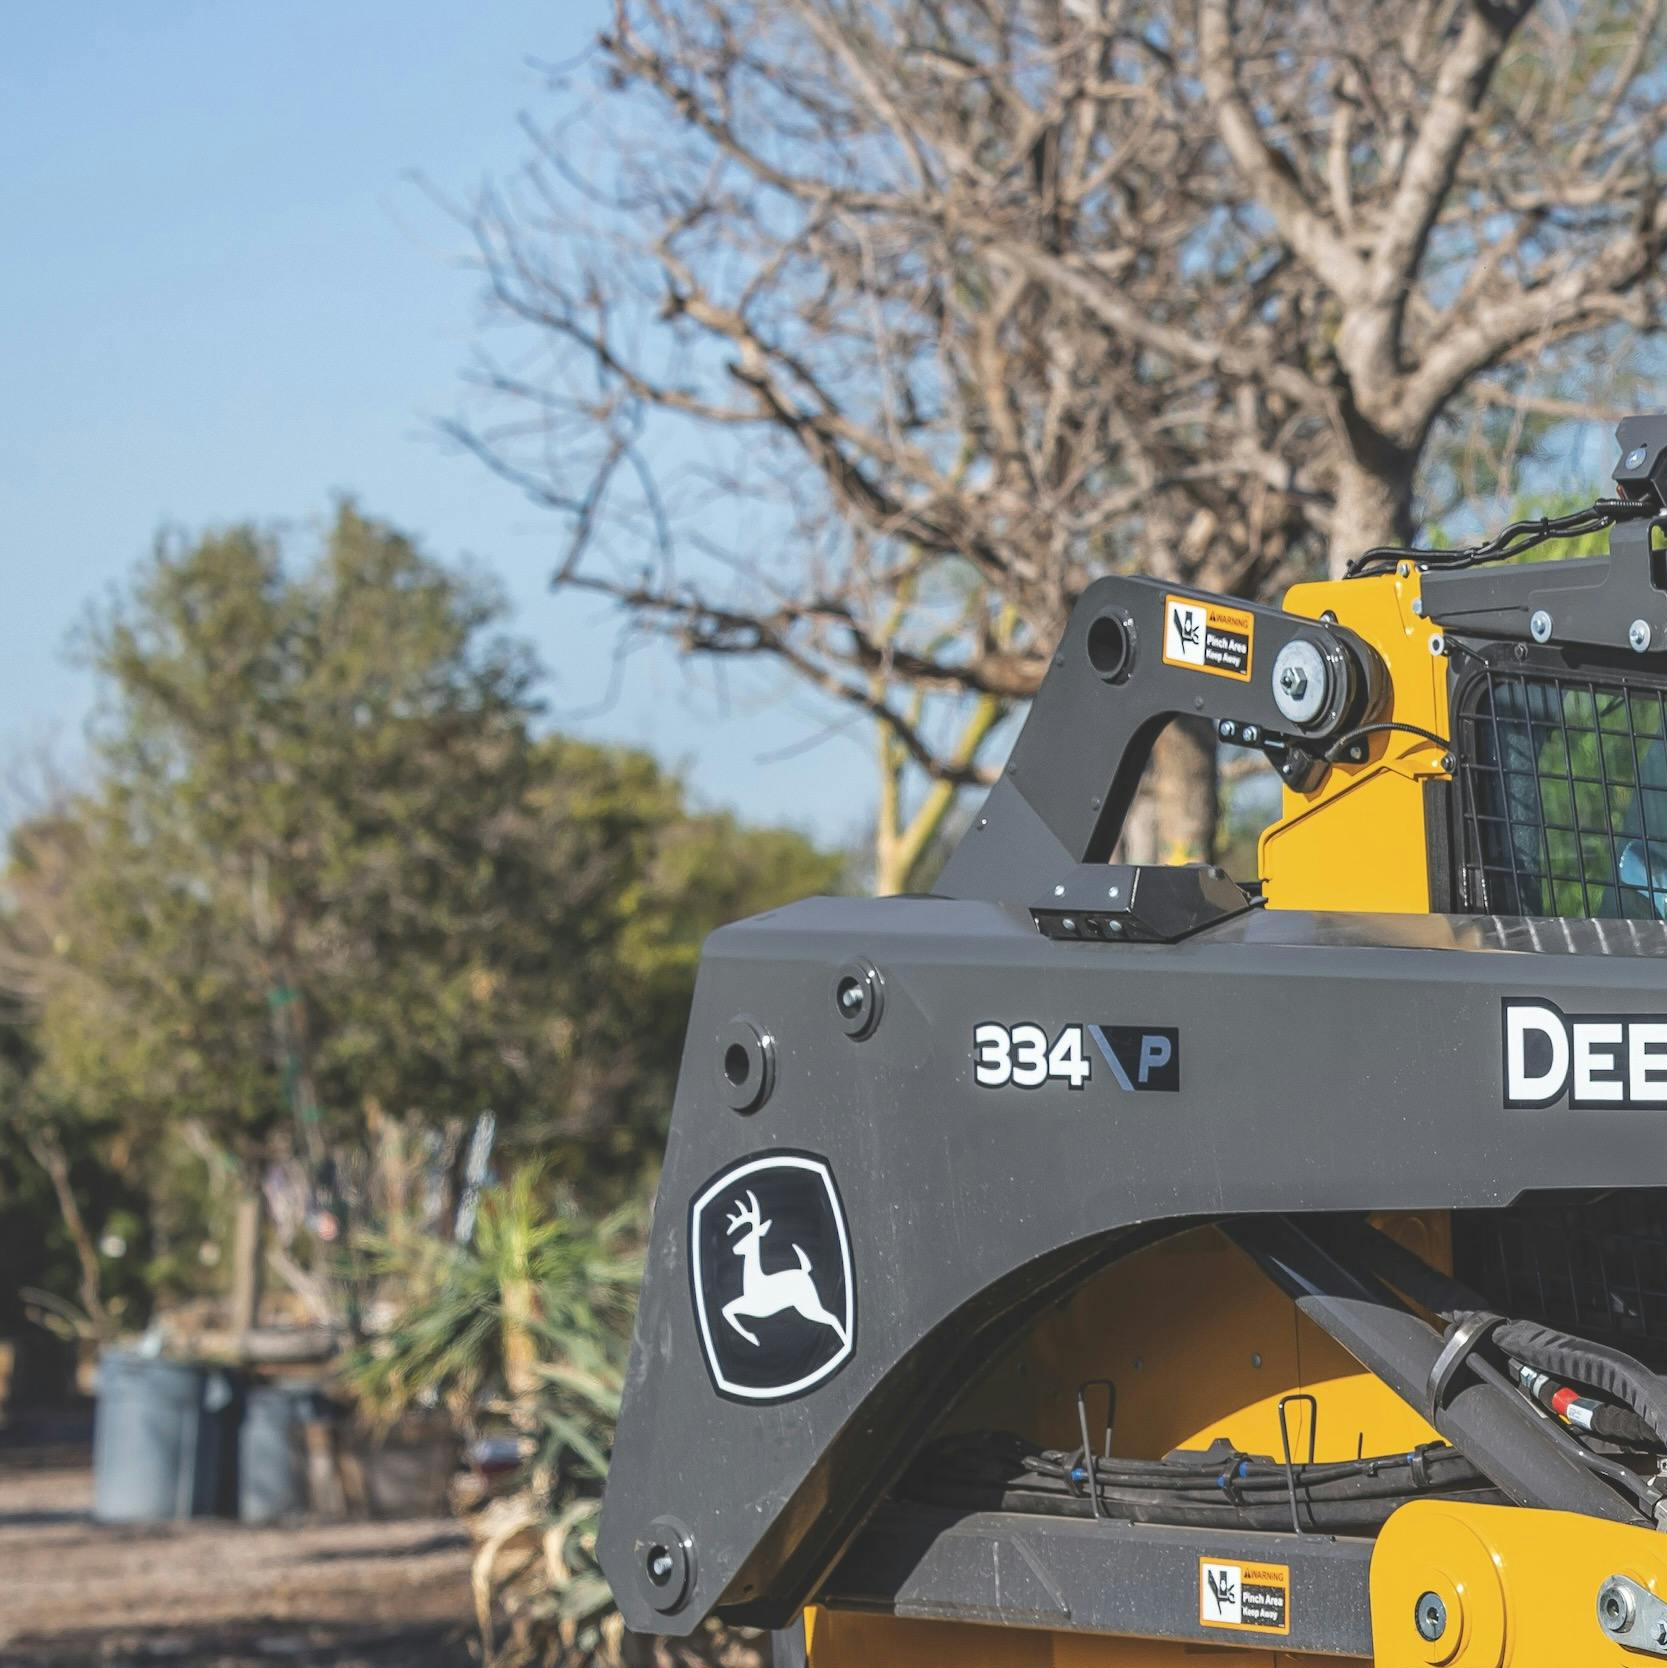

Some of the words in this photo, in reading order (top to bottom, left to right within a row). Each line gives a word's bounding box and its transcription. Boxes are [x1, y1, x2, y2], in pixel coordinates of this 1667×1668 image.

[1216, 614, 1249, 629] WARNING
[1206, 633, 1228, 650] Pinch
[1228, 639, 1247, 654] Area
[1205, 648, 1223, 663] Keep
[1223, 652, 1241, 668] Away
[975, 1024, 1090, 1086] 334
[1138, 1034, 1172, 1083] P
[1250, 1570, 1284, 1582] WARNING
[1242, 1591, 1264, 1604] Pinch
[1265, 1594, 1284, 1607] Area
[1242, 1606, 1259, 1619] Keep
[1260, 1608, 1278, 1621] Away
